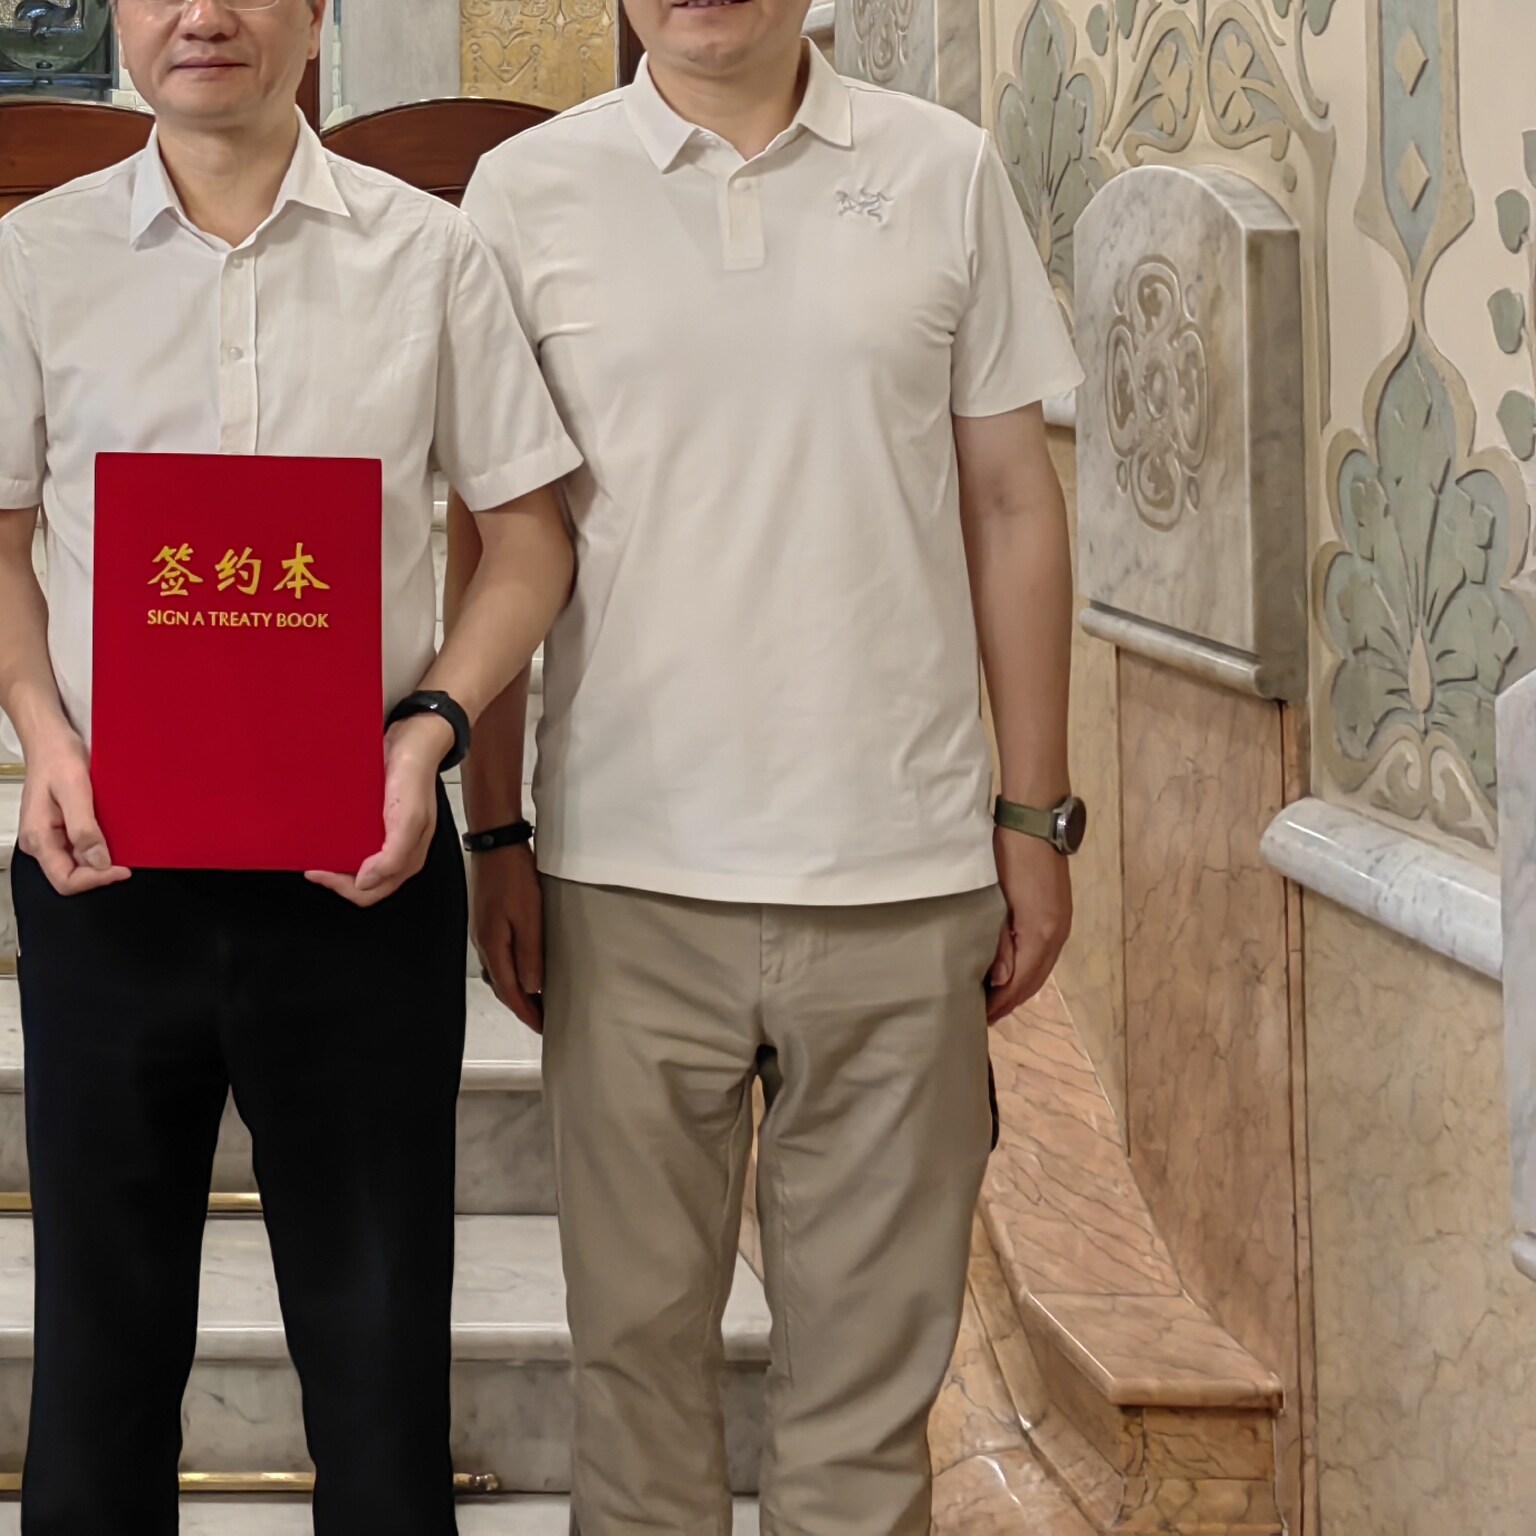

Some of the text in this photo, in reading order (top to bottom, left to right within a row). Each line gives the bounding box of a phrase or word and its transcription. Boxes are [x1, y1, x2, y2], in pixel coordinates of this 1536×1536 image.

[146, 542, 331, 599] 签约本
[146, 609, 329, 628] SIGN A TREATY BOOK
